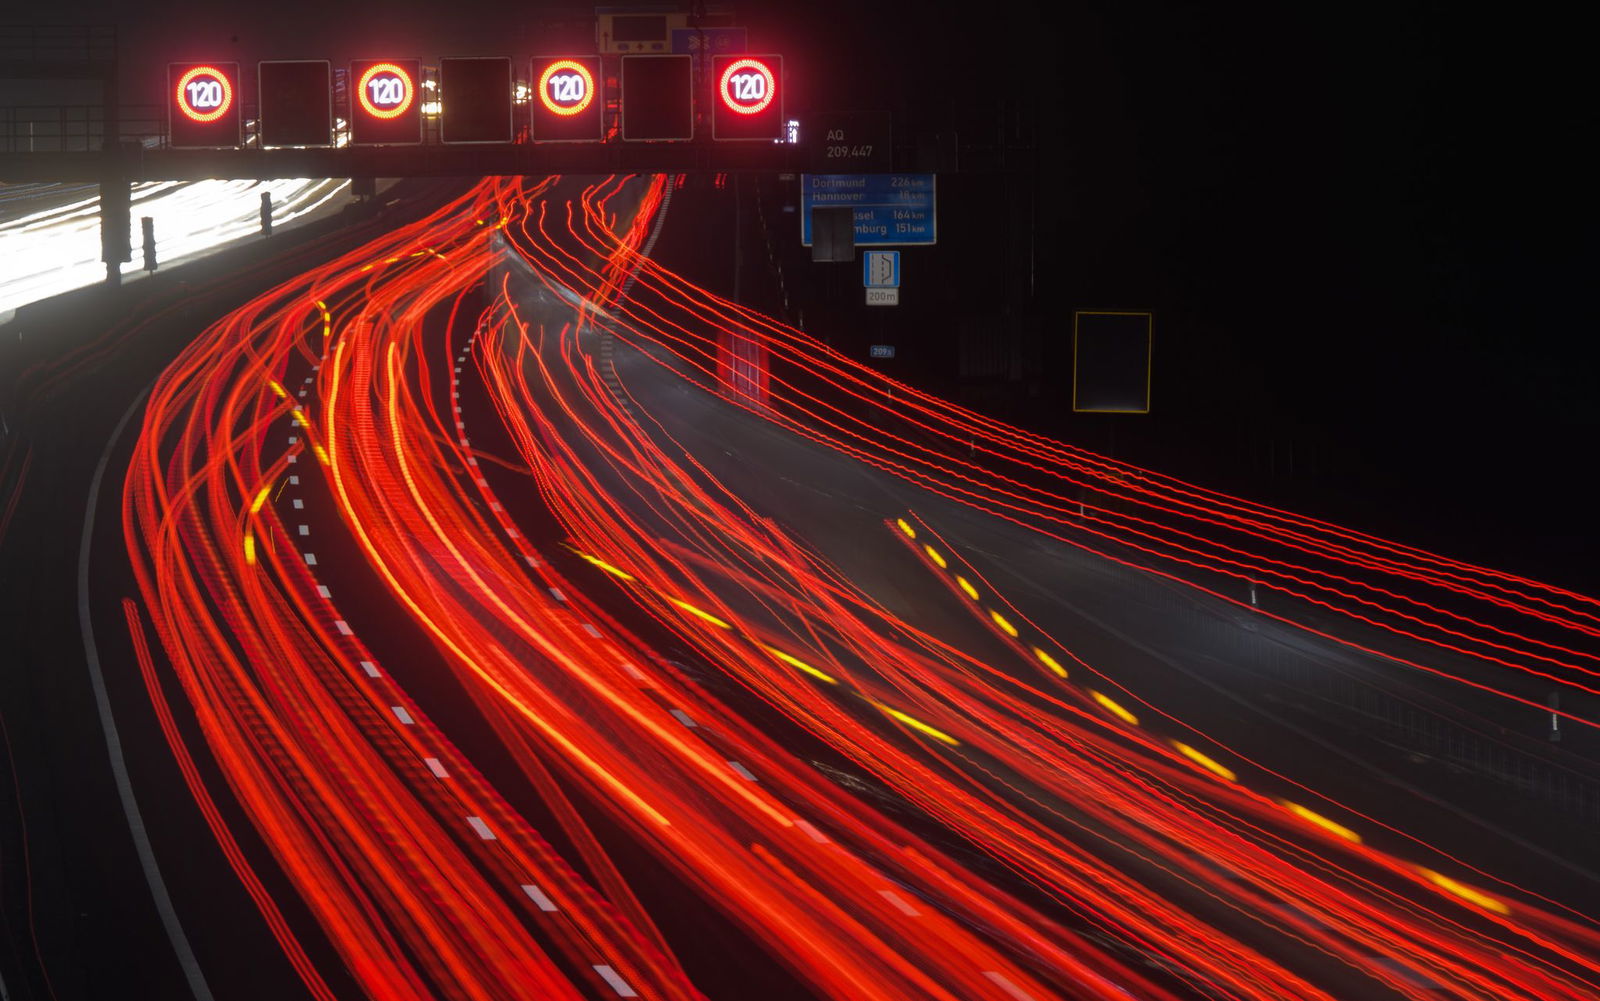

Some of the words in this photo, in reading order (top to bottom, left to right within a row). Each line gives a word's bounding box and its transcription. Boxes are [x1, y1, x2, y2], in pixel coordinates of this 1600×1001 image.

[368, 78, 403, 104] 120
[549, 75, 584, 101] 120
[730, 74, 765, 100] 120
[187, 81, 222, 107] 120
[826, 129, 844, 141] AQ
[812, 177, 866, 188] Dortmund
[812, 191, 864, 201] Hannover
[854, 209, 874, 220] ssel
[893, 210, 910, 219] 164
[854, 224, 887, 235] mburg
[896, 223, 911, 233] 151
